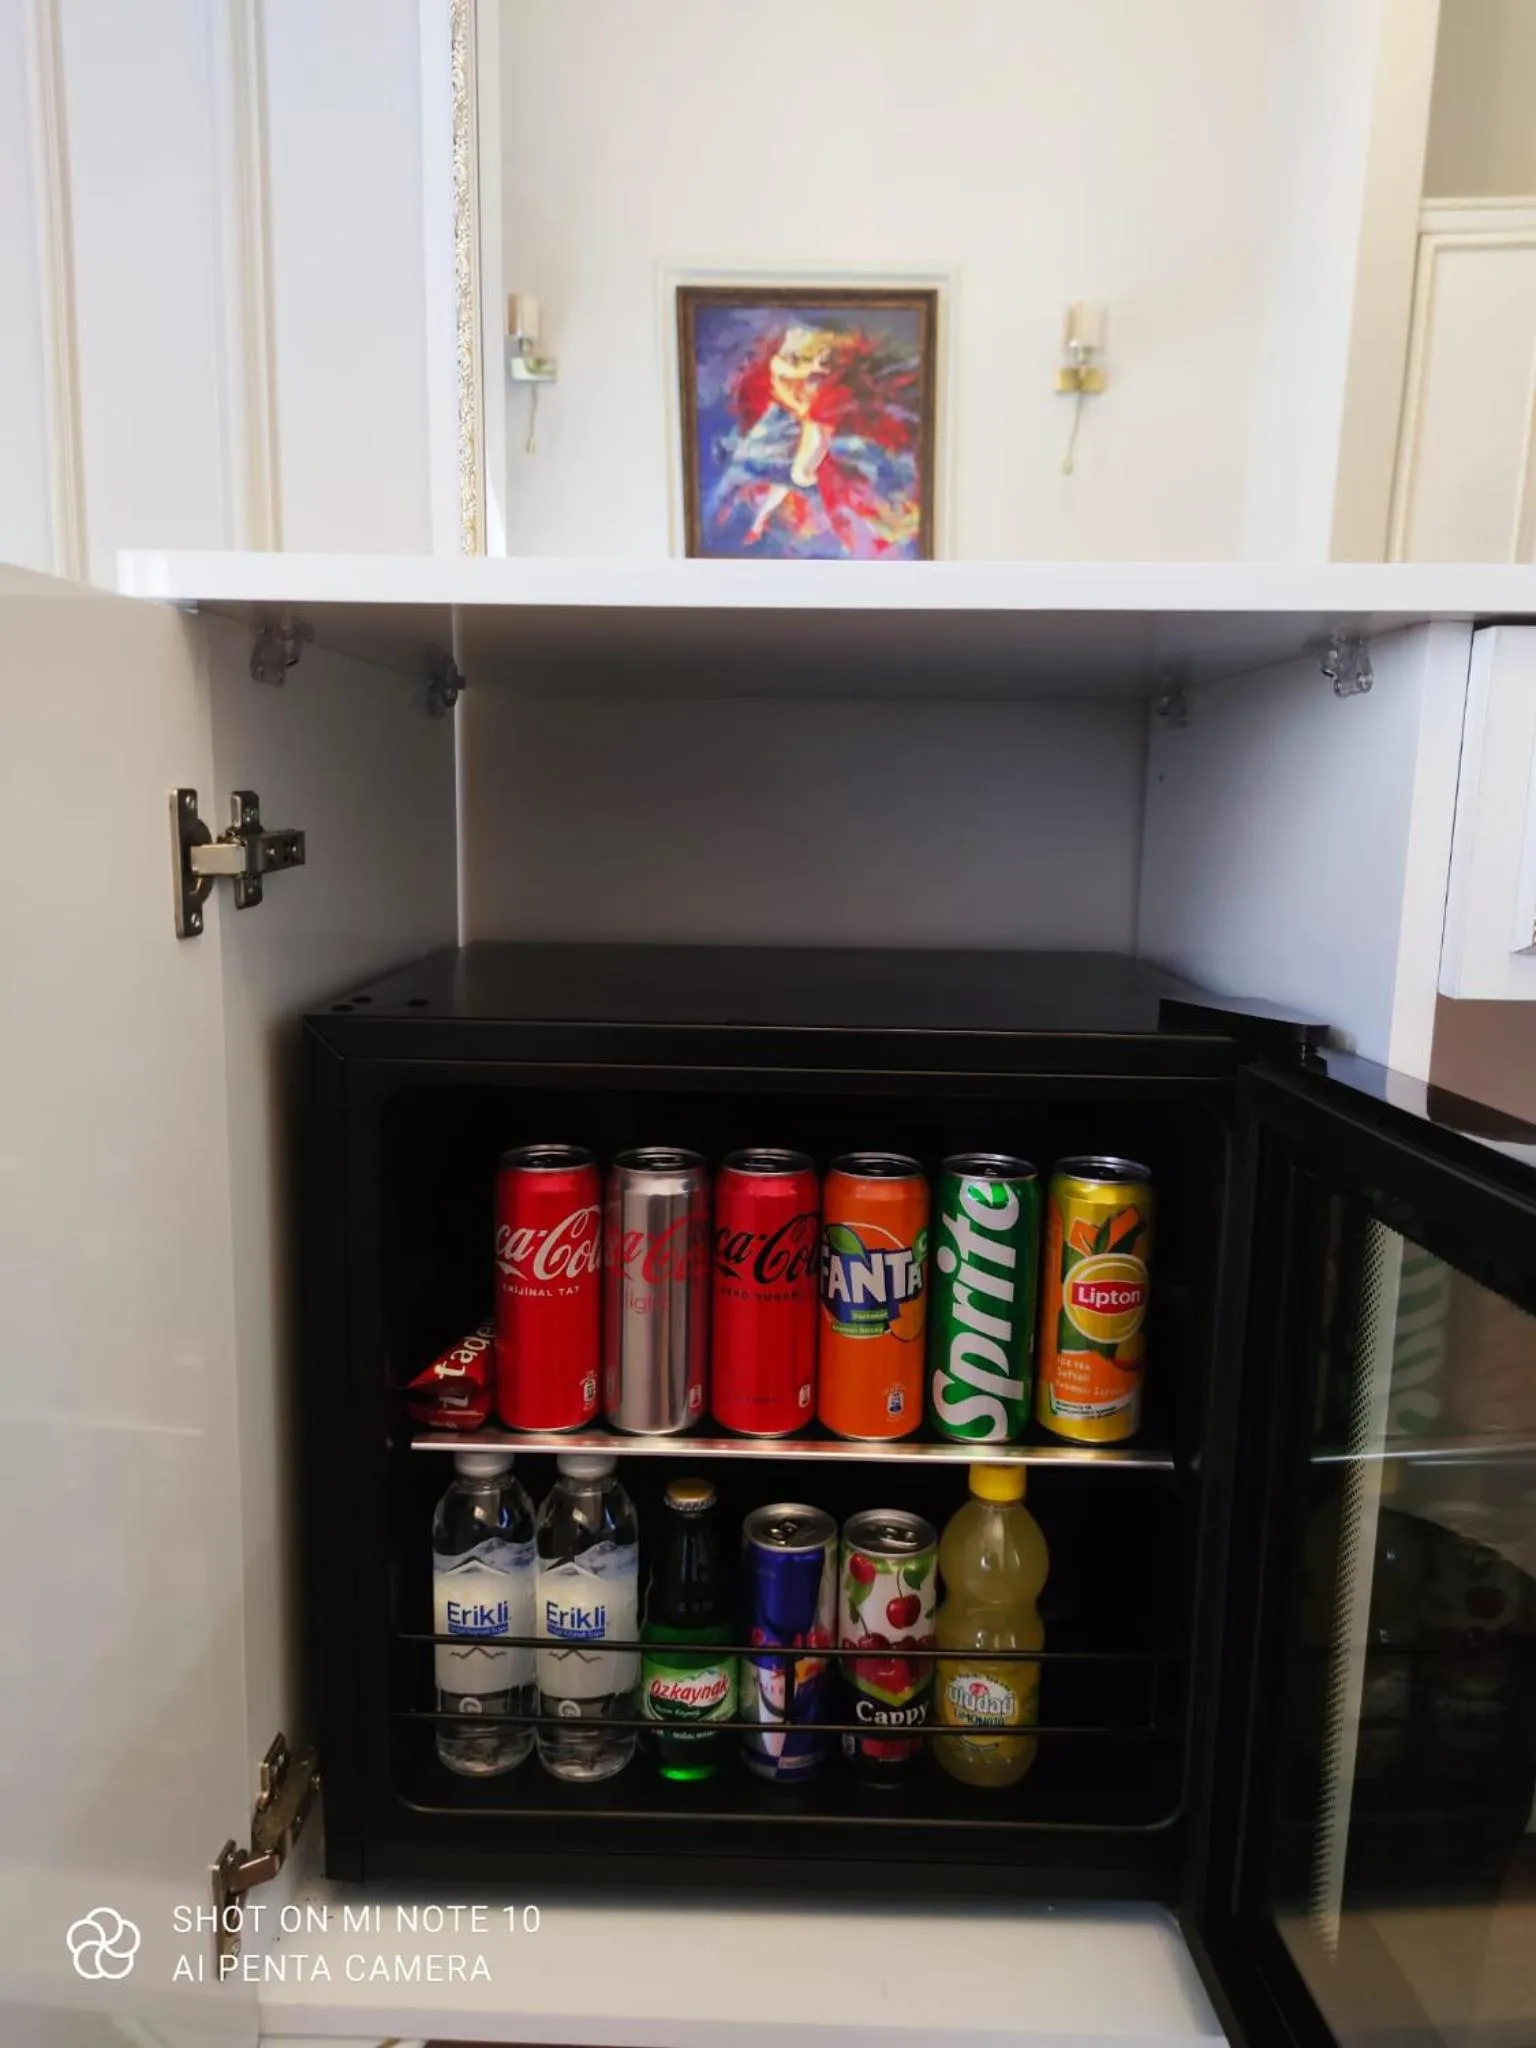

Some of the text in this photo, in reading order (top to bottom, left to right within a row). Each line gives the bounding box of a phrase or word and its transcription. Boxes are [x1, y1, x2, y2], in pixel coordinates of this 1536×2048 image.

[932, 1178, 1025, 1442] Sprite
[1077, 1286, 1141, 1308] Lipton
[447, 1600, 509, 1626] Erikli
[546, 1601, 606, 1629] Erikli
[855, 1699, 929, 1726] Cappy
